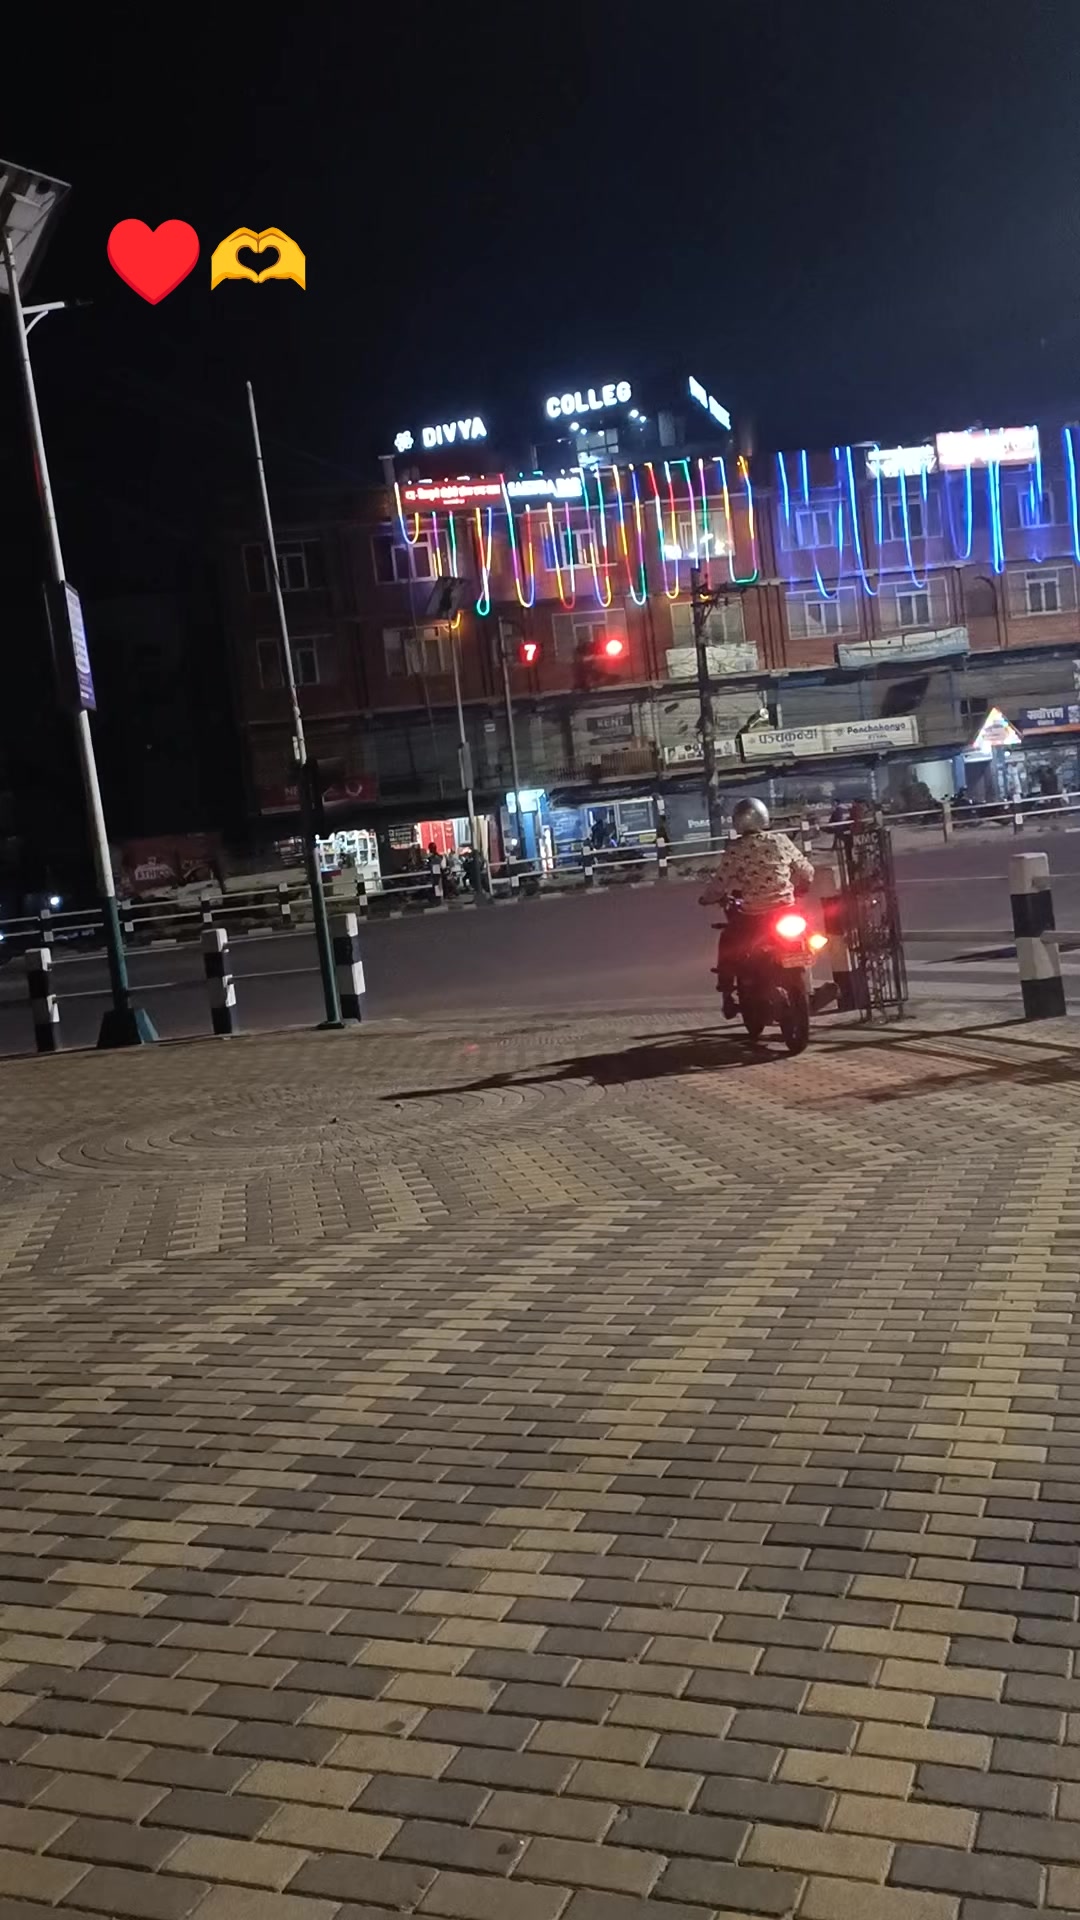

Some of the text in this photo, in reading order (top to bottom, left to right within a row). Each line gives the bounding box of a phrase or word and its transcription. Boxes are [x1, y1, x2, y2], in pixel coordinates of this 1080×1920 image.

[546, 381, 632, 418] COLLEG
[422, 417, 488, 448] DIVYA
[524, 644, 537, 661] 7
